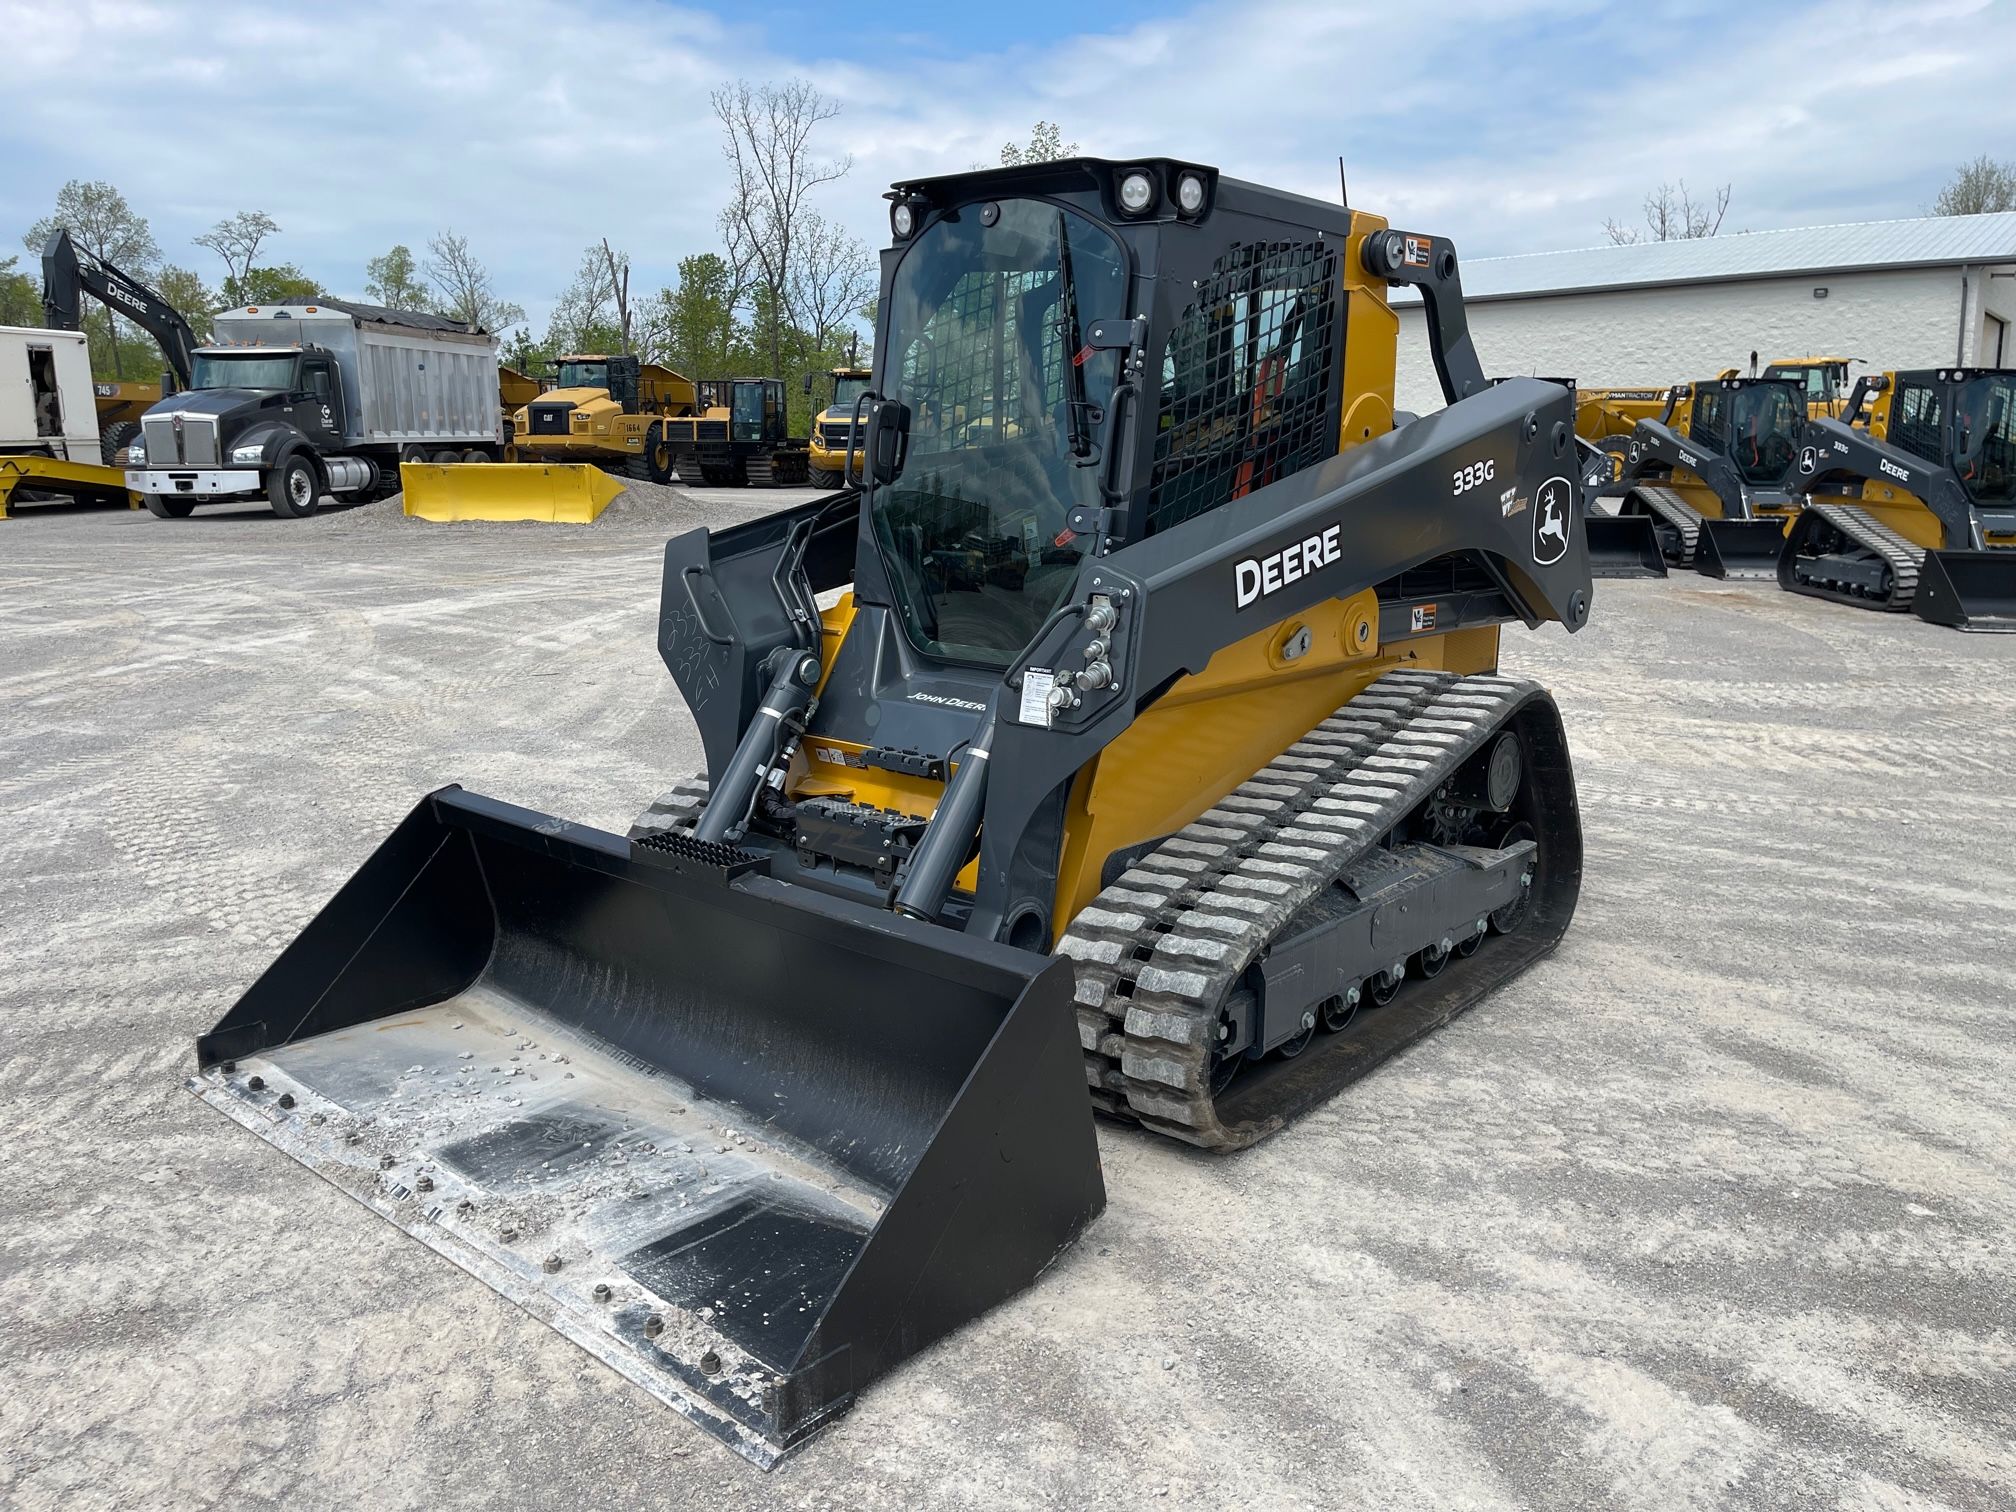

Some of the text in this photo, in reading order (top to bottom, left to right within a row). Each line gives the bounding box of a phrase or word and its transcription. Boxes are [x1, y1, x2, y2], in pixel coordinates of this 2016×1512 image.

[107, 282, 148, 314] DEERE
[97, 385, 111, 396] 745
[543, 414, 553, 422] CAT
[626, 423, 640, 433] 1664
[1833, 441, 1848, 454] 333G
[1679, 450, 1697, 467] DEERE
[1453, 459, 1494, 496] 333G
[1880, 458, 1910, 481] DEERE
[1235, 525, 1341, 608] DEERE
[907, 692, 987, 711] JOHN DEER
